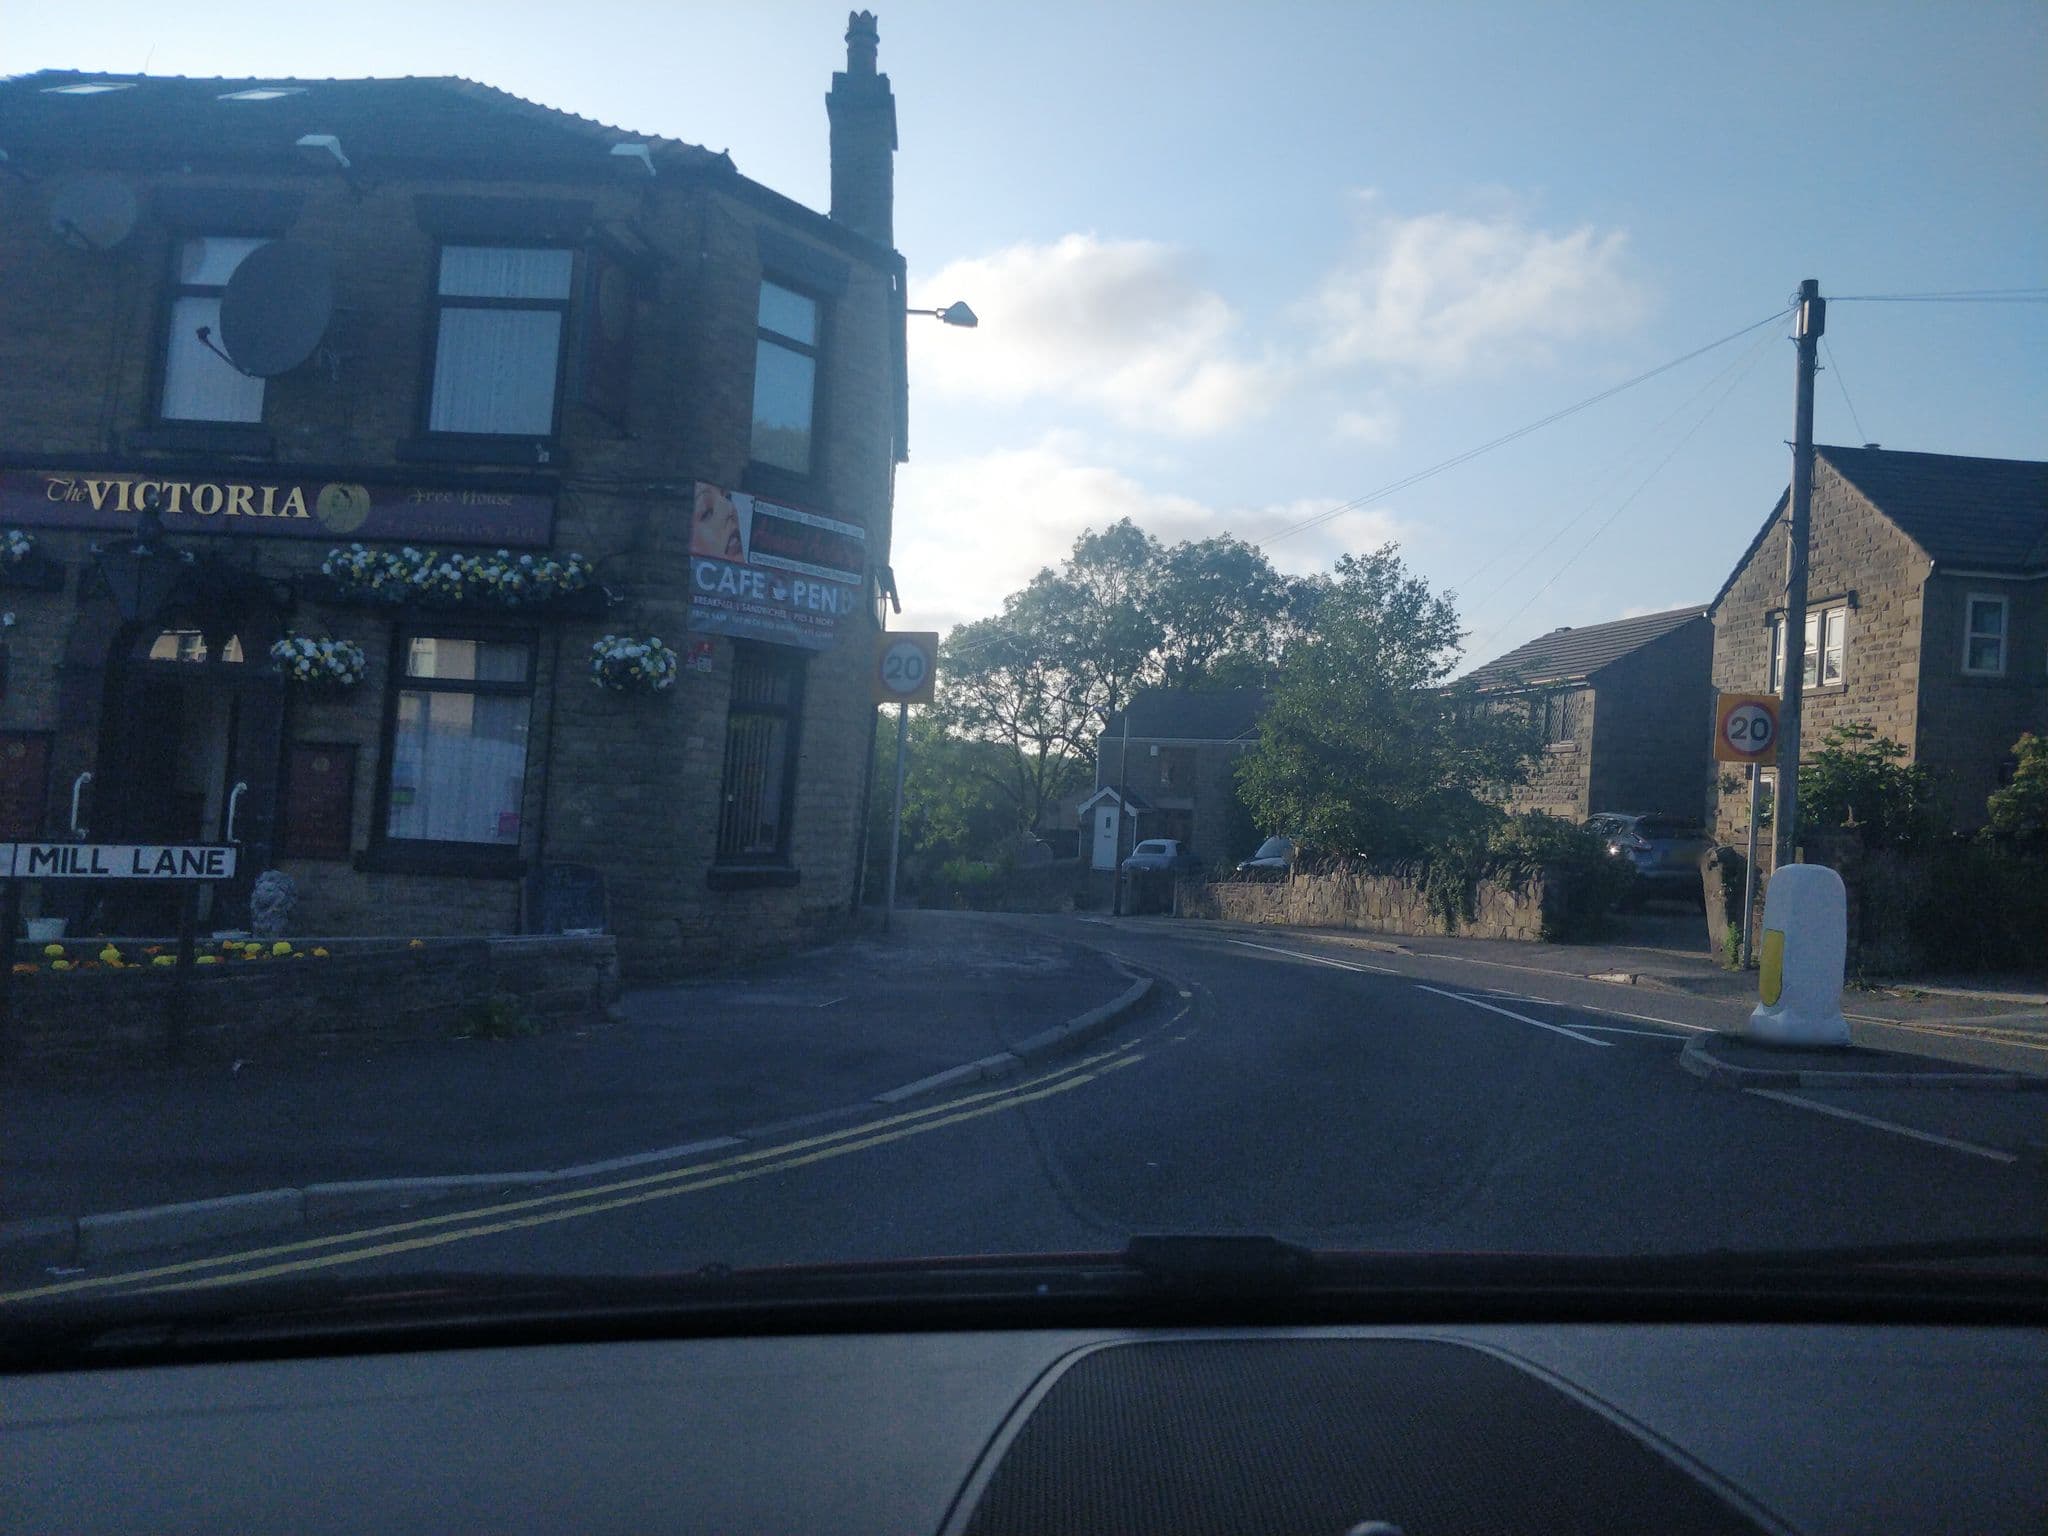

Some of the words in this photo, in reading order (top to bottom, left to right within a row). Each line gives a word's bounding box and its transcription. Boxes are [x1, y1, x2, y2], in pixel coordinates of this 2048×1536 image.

[47, 478, 86, 503] The
[85, 480, 311, 518] VICTORIA
[695, 561, 766, 600] CAFE
[886, 655, 923, 681] 20
[1730, 717, 1770, 741] 20
[28, 847, 109, 874] MILL
[132, 848, 225, 875] LANE
